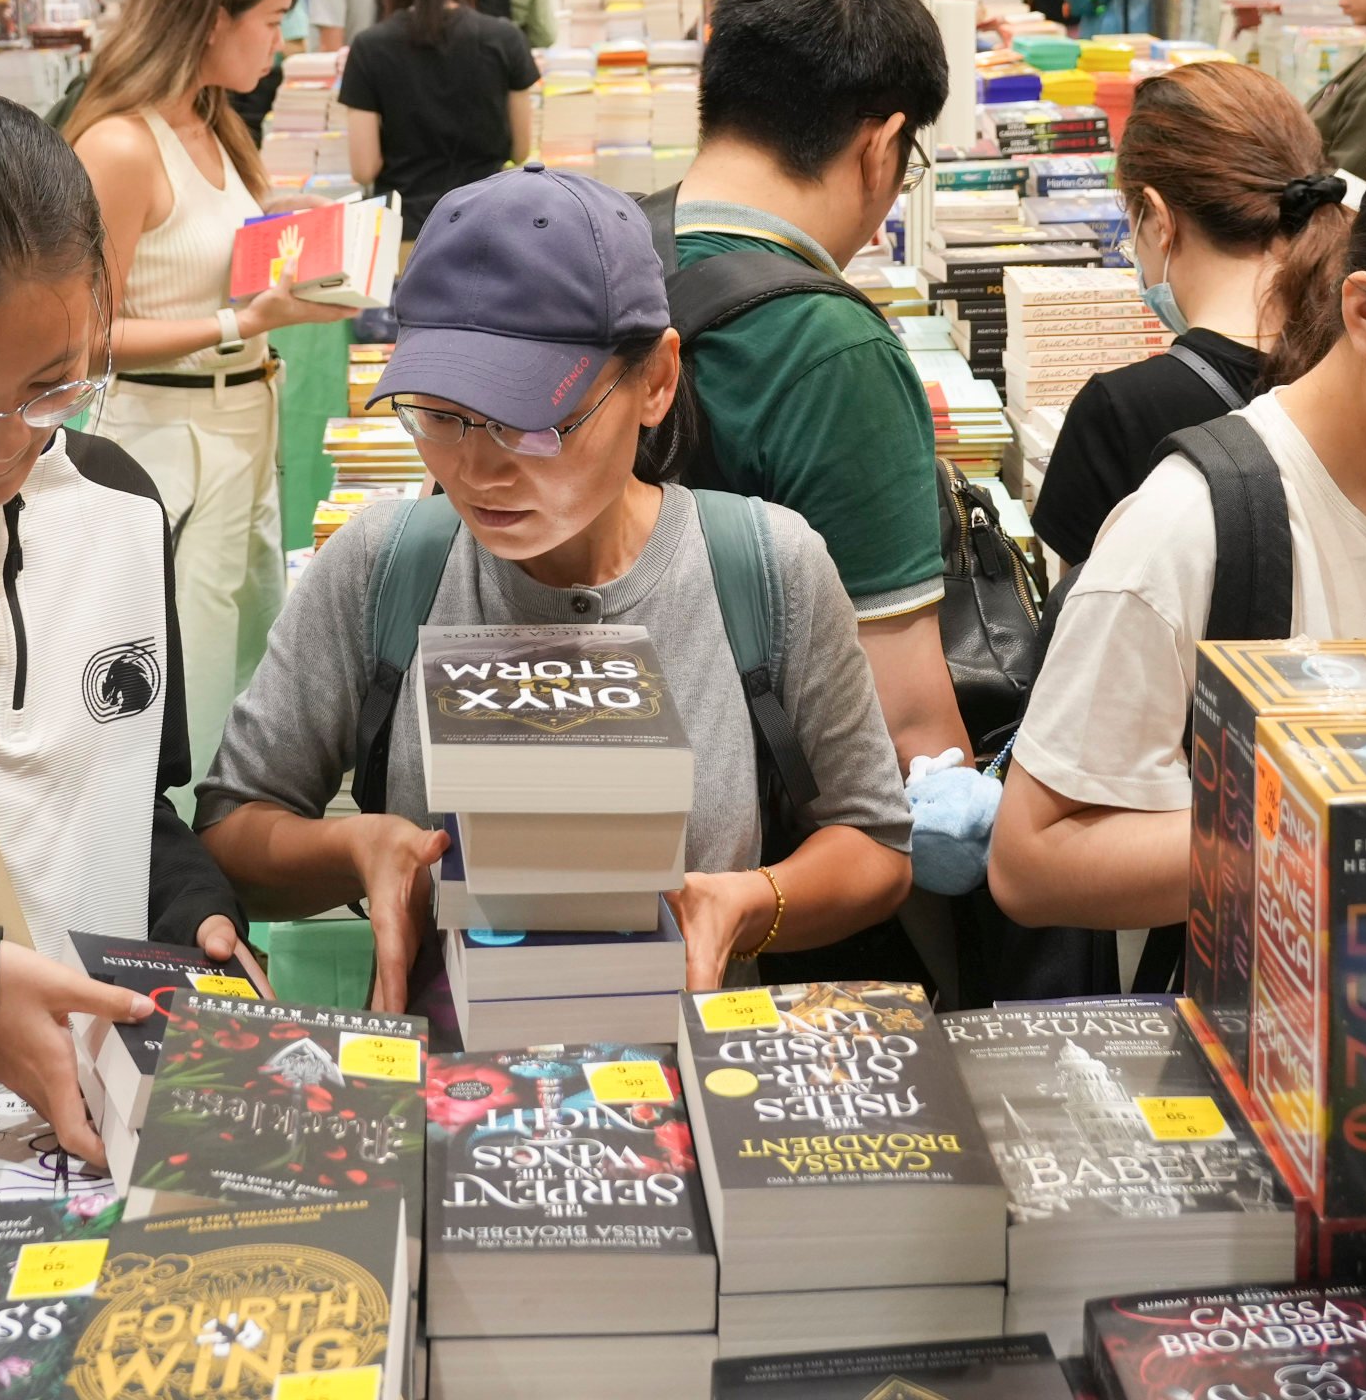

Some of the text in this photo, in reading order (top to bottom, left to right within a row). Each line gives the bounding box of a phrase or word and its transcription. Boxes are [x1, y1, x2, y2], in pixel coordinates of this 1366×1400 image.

[1047, 177, 1106, 188] Harlan Coben
[551, 356, 591, 407] ARTENGO
[442, 629, 622, 641] REBECCA YARROS
[442, 660, 637, 681] STORM
[458, 685, 642, 712] ONYX
[188, 996, 303, 1018] ROBERTS
[962, 1010, 1160, 1024] NEW YORK TIMES BESTSELLER
[317, 1011, 412, 1030] LAUREN
[1022, 1018, 1171, 1037] KUANG
[719, 1034, 918, 1063] CURSED
[754, 1086, 926, 1122] ASHES
[739, 1134, 962, 1158] BROADBENT
[778, 1151, 931, 1174] CARISSA
[1022, 1153, 1237, 1190] BABEL
[442, 1172, 684, 1210] SERPENT
[1088, 1183, 1218, 1196] ARCANE HISTORY
[144, 1207, 296, 1232] DISCOVER THRILLING
[188, 1212, 321, 1233] GLOBAL PHENOMENON
[442, 1224, 693, 1240] CARISSA BROADBENT
[1137, 1286, 1319, 1312] SUNDAY TIMES BESTSELLING
[102, 1281, 359, 1349] FOURTH
[1189, 1300, 1350, 1330] CARISSA
[97, 1328, 359, 1400] WING
